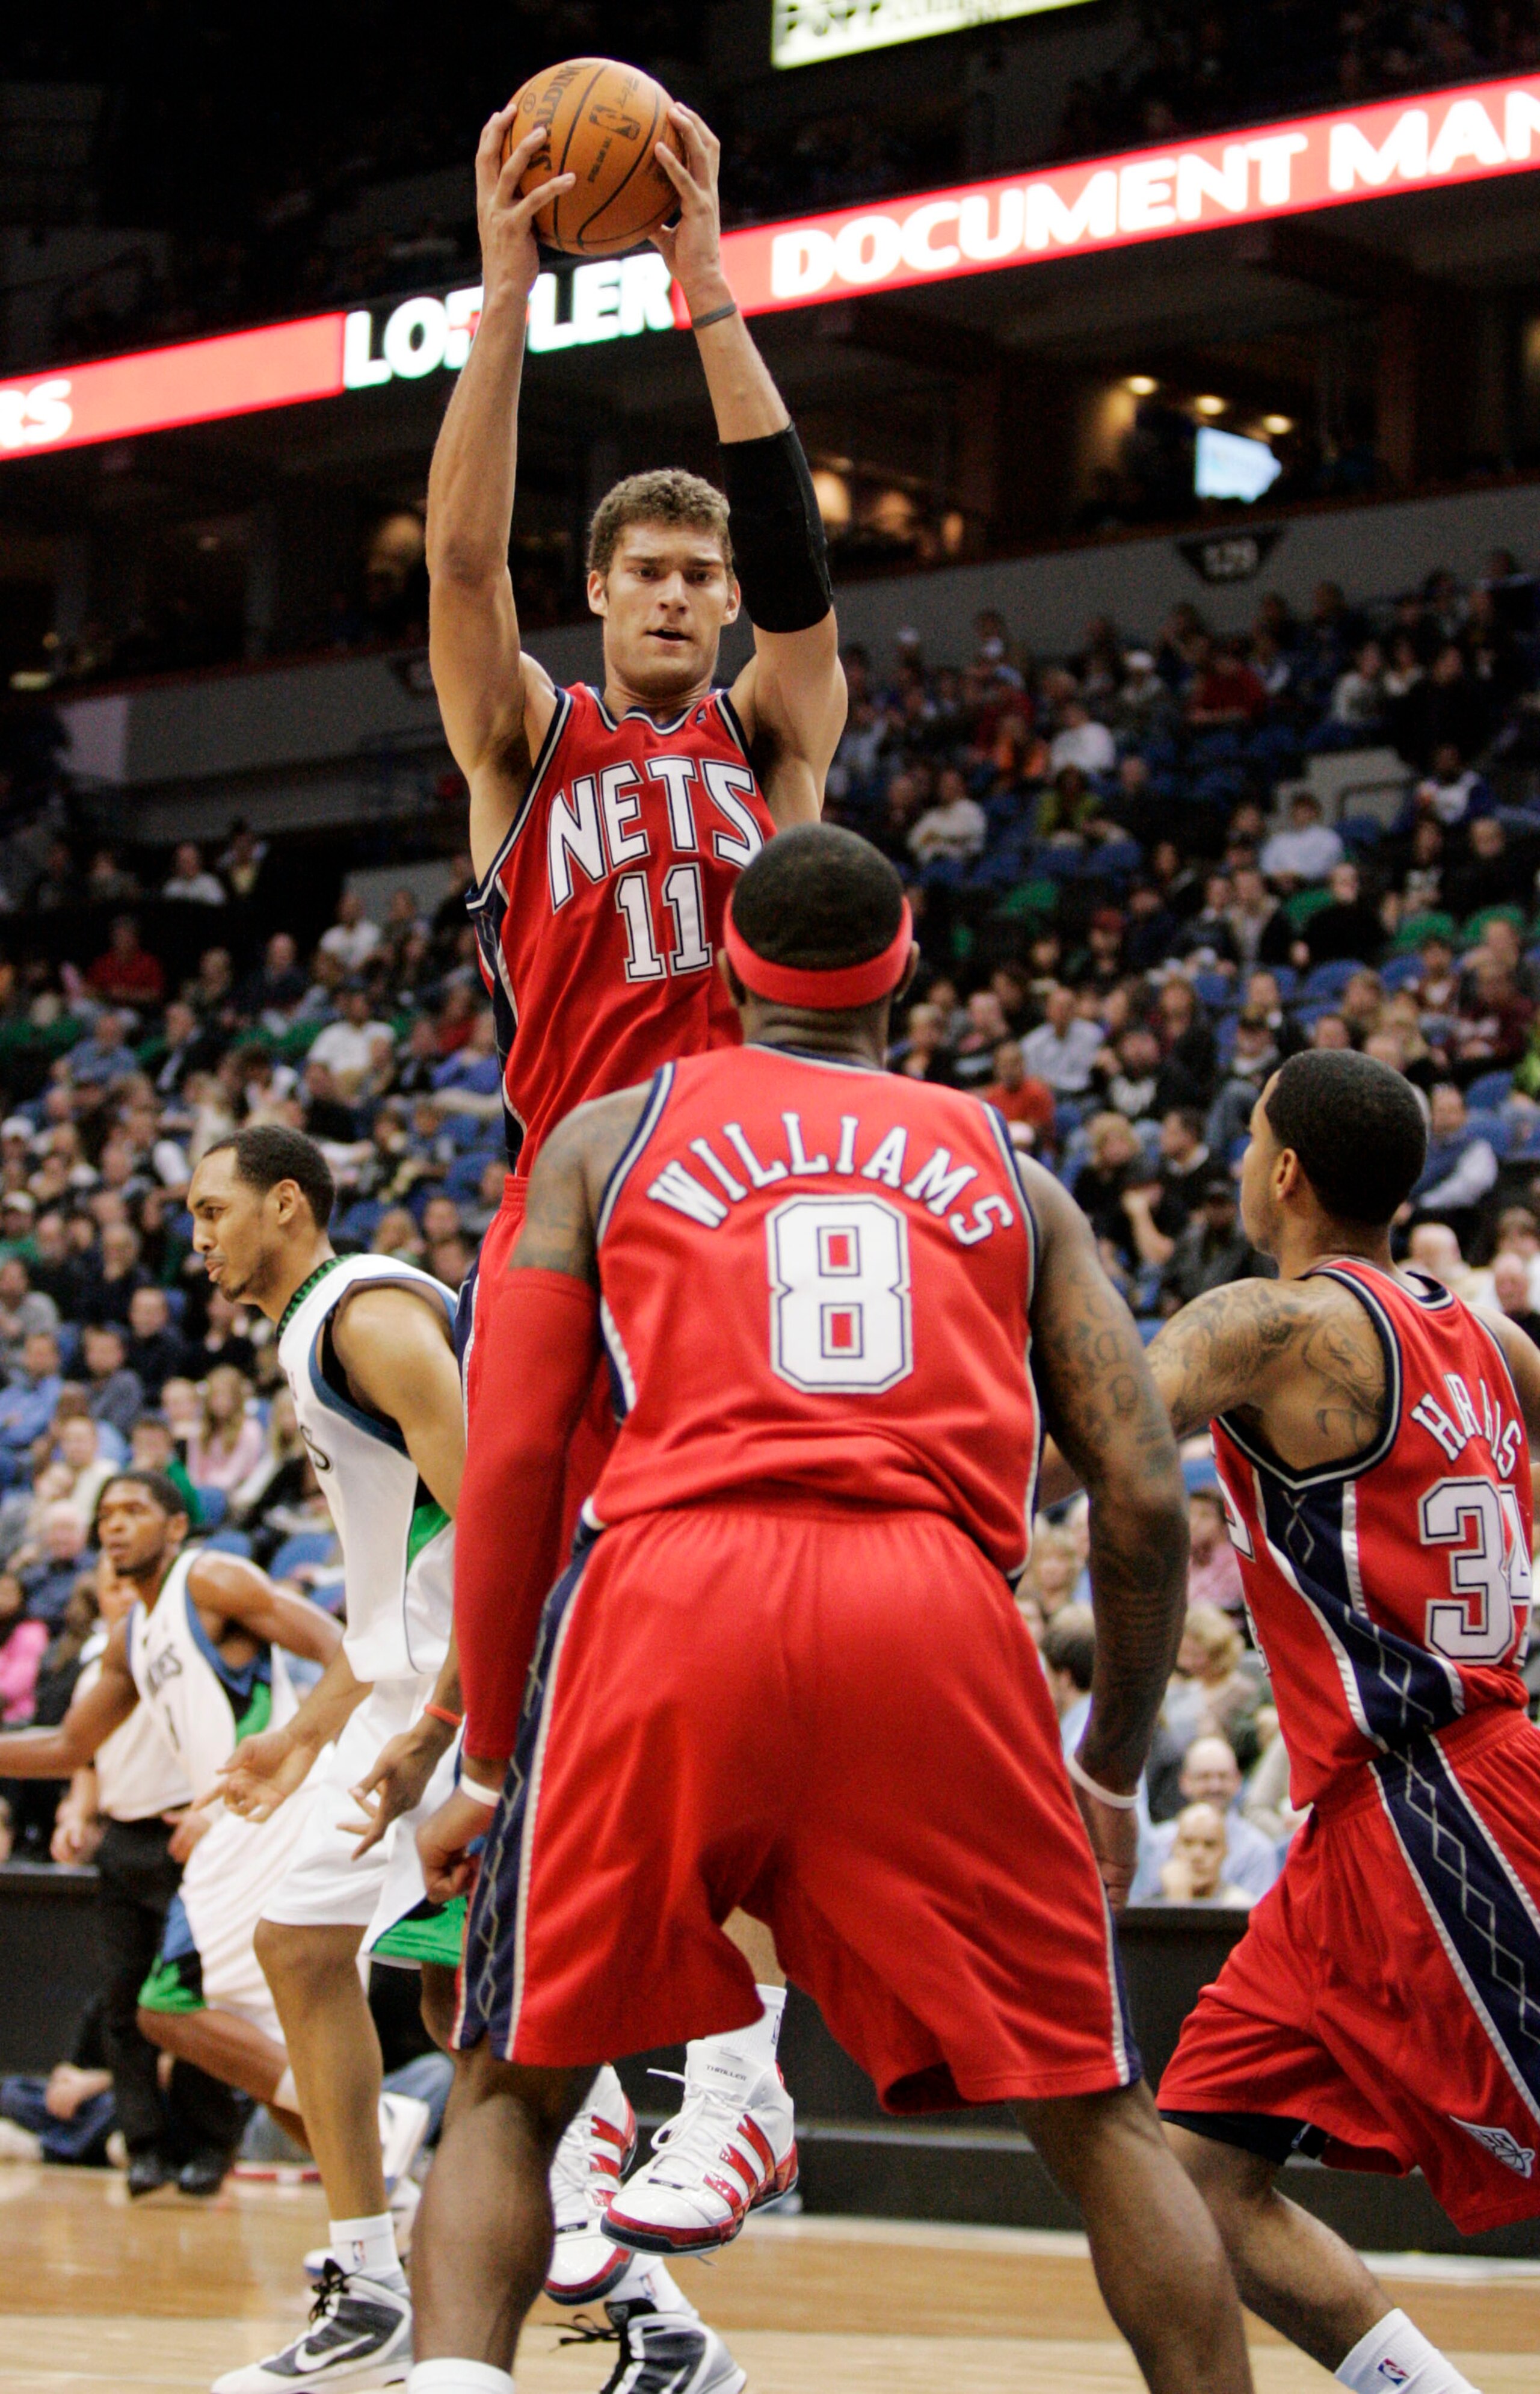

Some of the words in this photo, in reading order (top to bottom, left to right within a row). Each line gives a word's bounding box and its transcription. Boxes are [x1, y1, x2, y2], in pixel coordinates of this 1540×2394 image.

[771, 133, 1308, 300] DOCUMENT
[344, 252, 674, 390] LOFLER
[547, 754, 763, 916] NETS
[614, 862, 713, 983] 11
[646, 1111, 1014, 1246] WILLIAMS
[765, 1192, 913, 1395] 8
